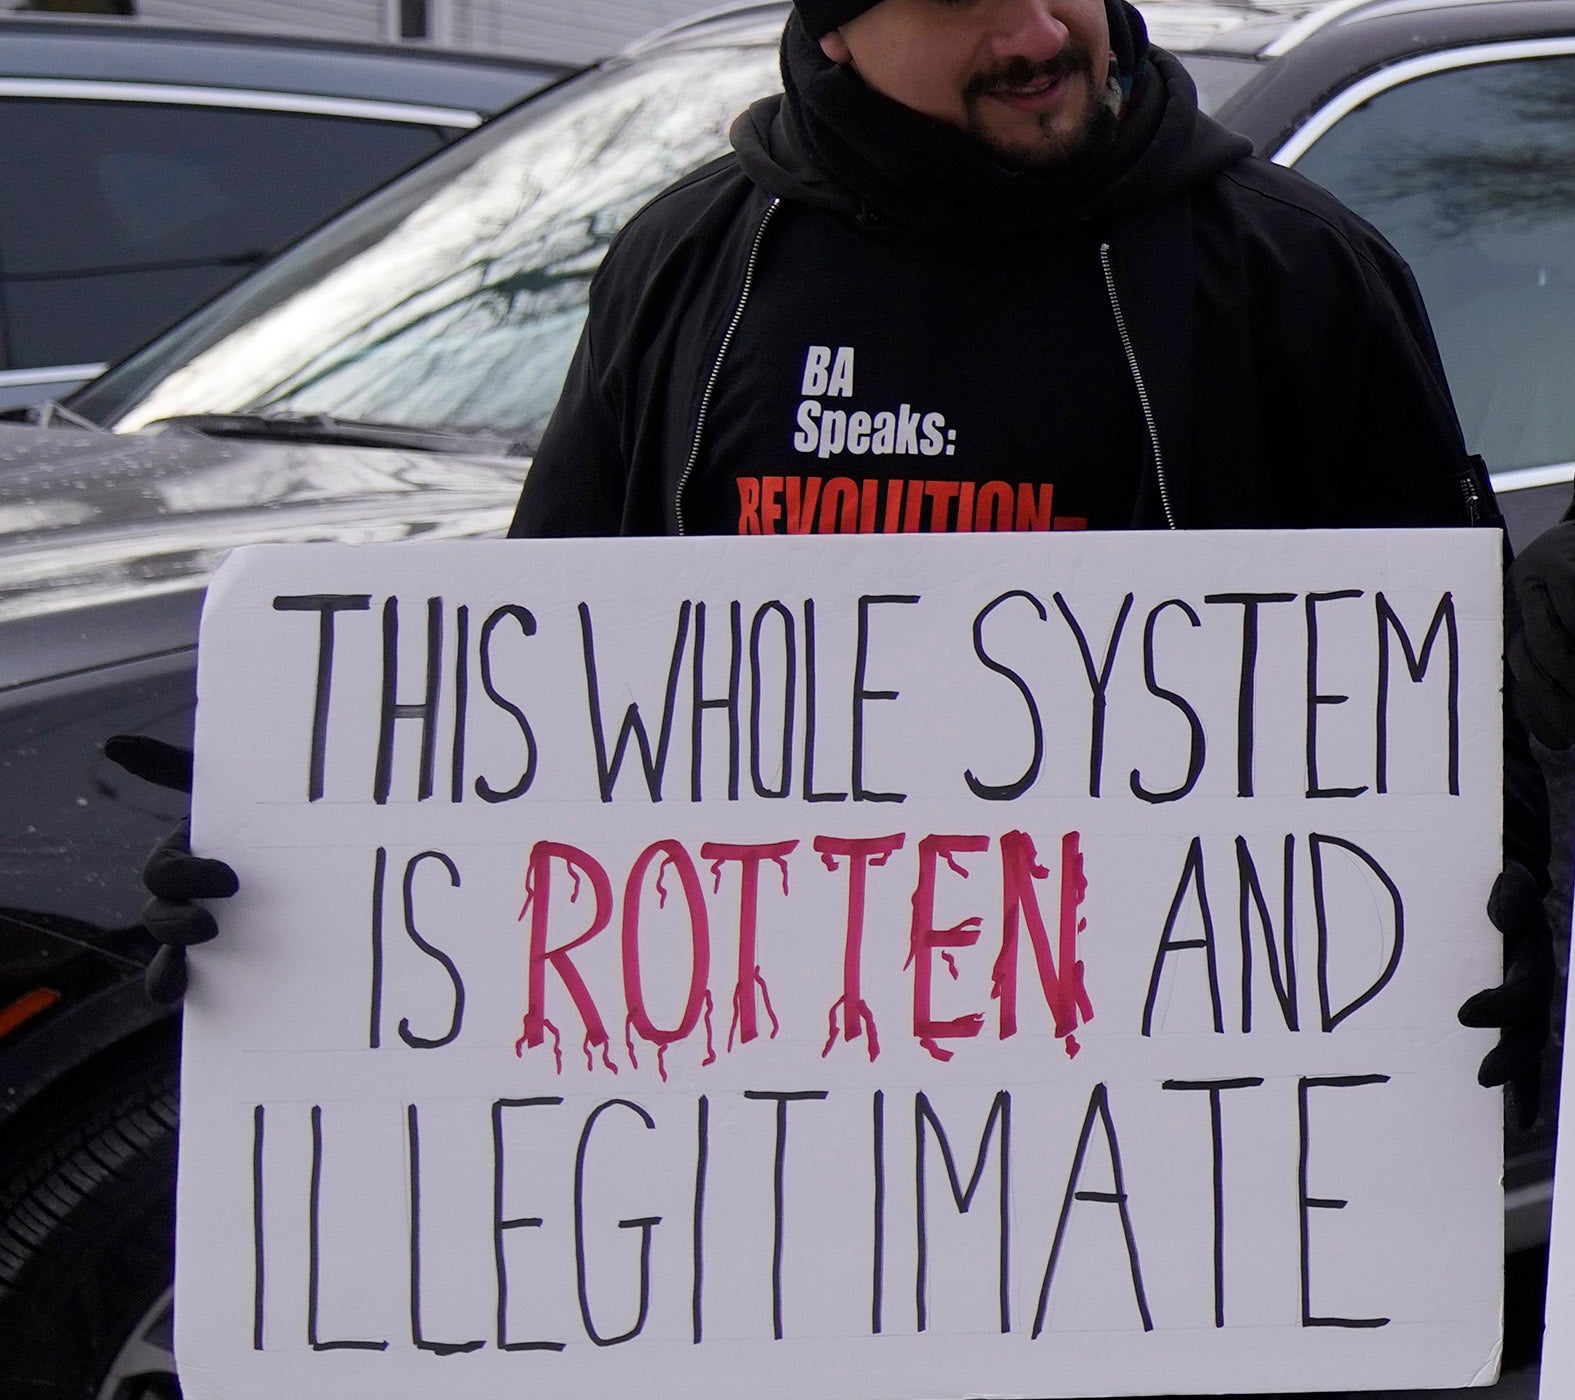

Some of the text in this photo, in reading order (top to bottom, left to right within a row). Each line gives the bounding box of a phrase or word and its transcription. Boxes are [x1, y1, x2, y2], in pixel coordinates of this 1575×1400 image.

[794, 400, 956, 458] Speaks:
[802, 346, 854, 397] BA
[272, 589, 1459, 805] THIS WHOLE SYSTEM
[370, 830, 1404, 1080] IS ROTTEN AND
[253, 1074, 1391, 1356] ILLEGITIMATE
